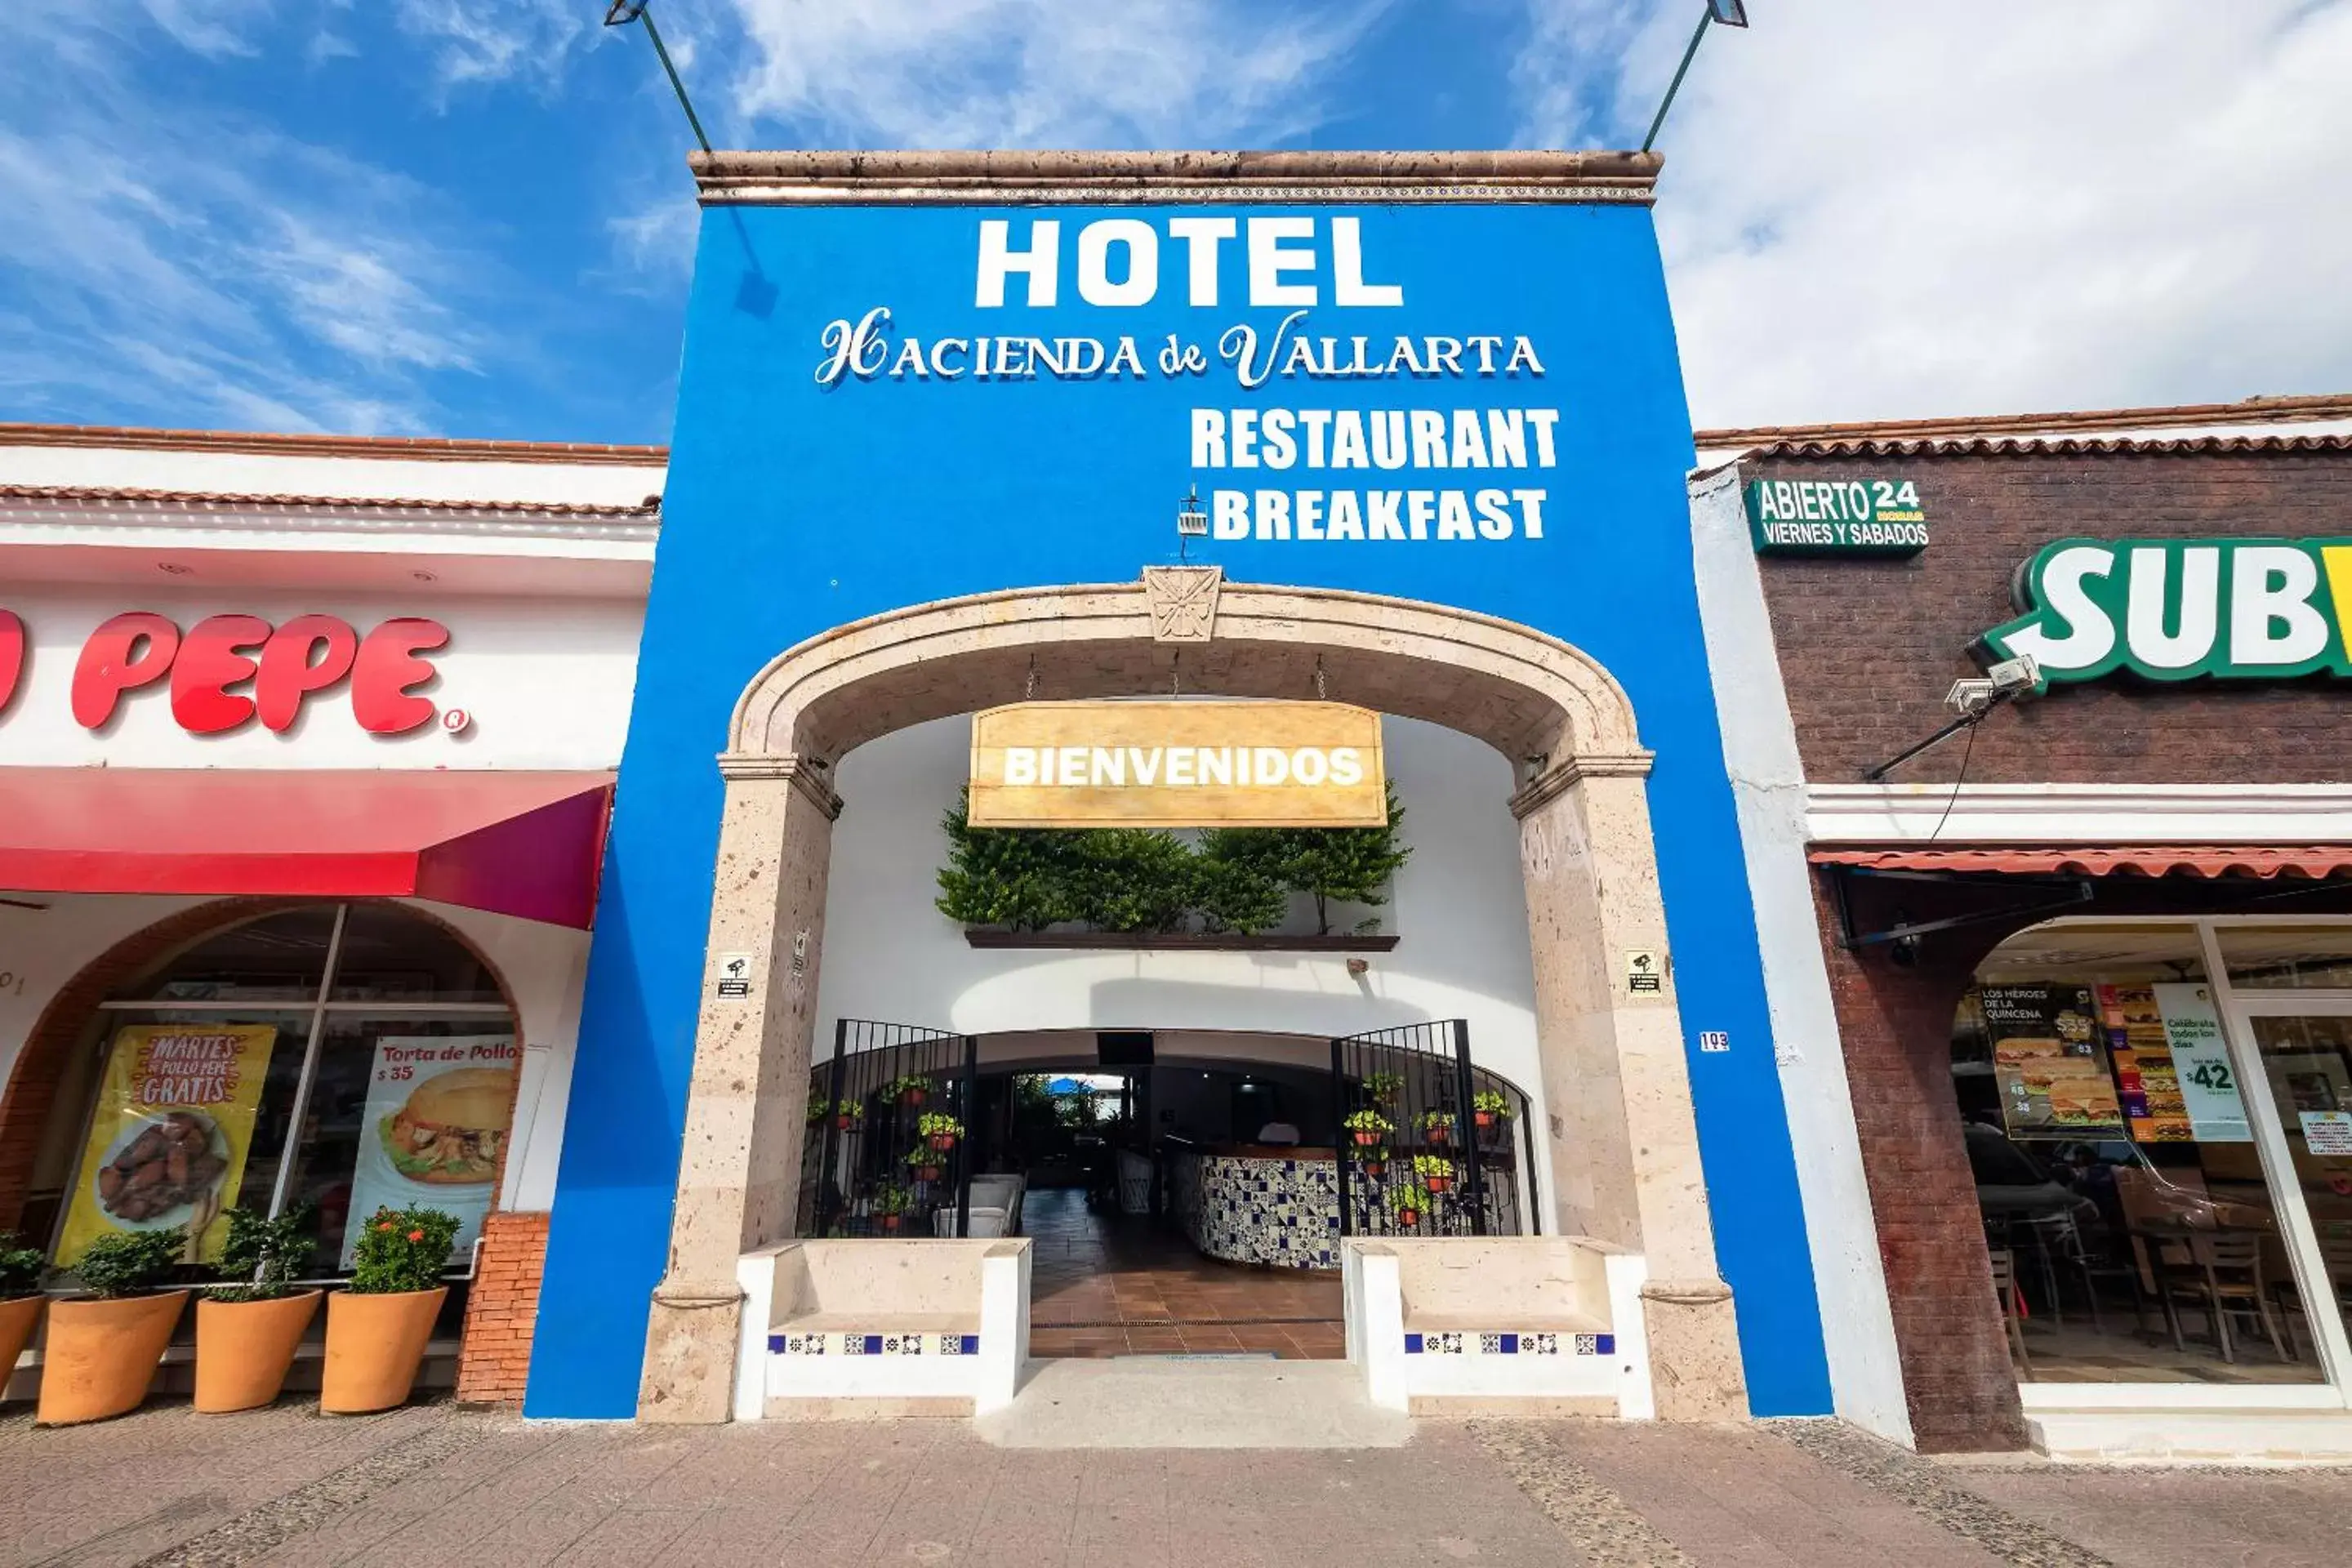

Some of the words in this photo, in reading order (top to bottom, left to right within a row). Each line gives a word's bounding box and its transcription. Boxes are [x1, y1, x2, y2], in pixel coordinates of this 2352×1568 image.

[976, 217, 1404, 308] HOTEL
[815, 308, 1147, 383] HACIENDA
[1159, 334, 1206, 374] de
[1218, 310, 1545, 386] VALLARTA
[1192, 408, 1559, 469] RESTAURANT
[1213, 489, 1547, 540] BREAKFAST
[1761, 481, 1870, 521] ABIERTO
[1872, 481, 1920, 507] 24
[1762, 523, 1833, 546] VIERNES
[1834, 523, 1846, 546] Y
[1851, 523, 1930, 546] SABADOS
[2000, 546, 2352, 669] SUB
[71, 612, 448, 736] PEPE
[1003, 746, 1362, 786] BIENVENIDOS
[1982, 989, 2003, 999] LOS
[1986, 1009, 2042, 1019] QUINCENA
[153, 1036, 236, 1060] MARTES
[383, 1045, 435, 1062] Torta
[440, 1045, 464, 1061] de
[470, 1043, 518, 1061] Pollo
[161, 1061, 199, 1076] POLLO
[200, 1061, 229, 1076] PEPE
[391, 1066, 414, 1080] 35
[143, 1076, 227, 1103] GRATIS
